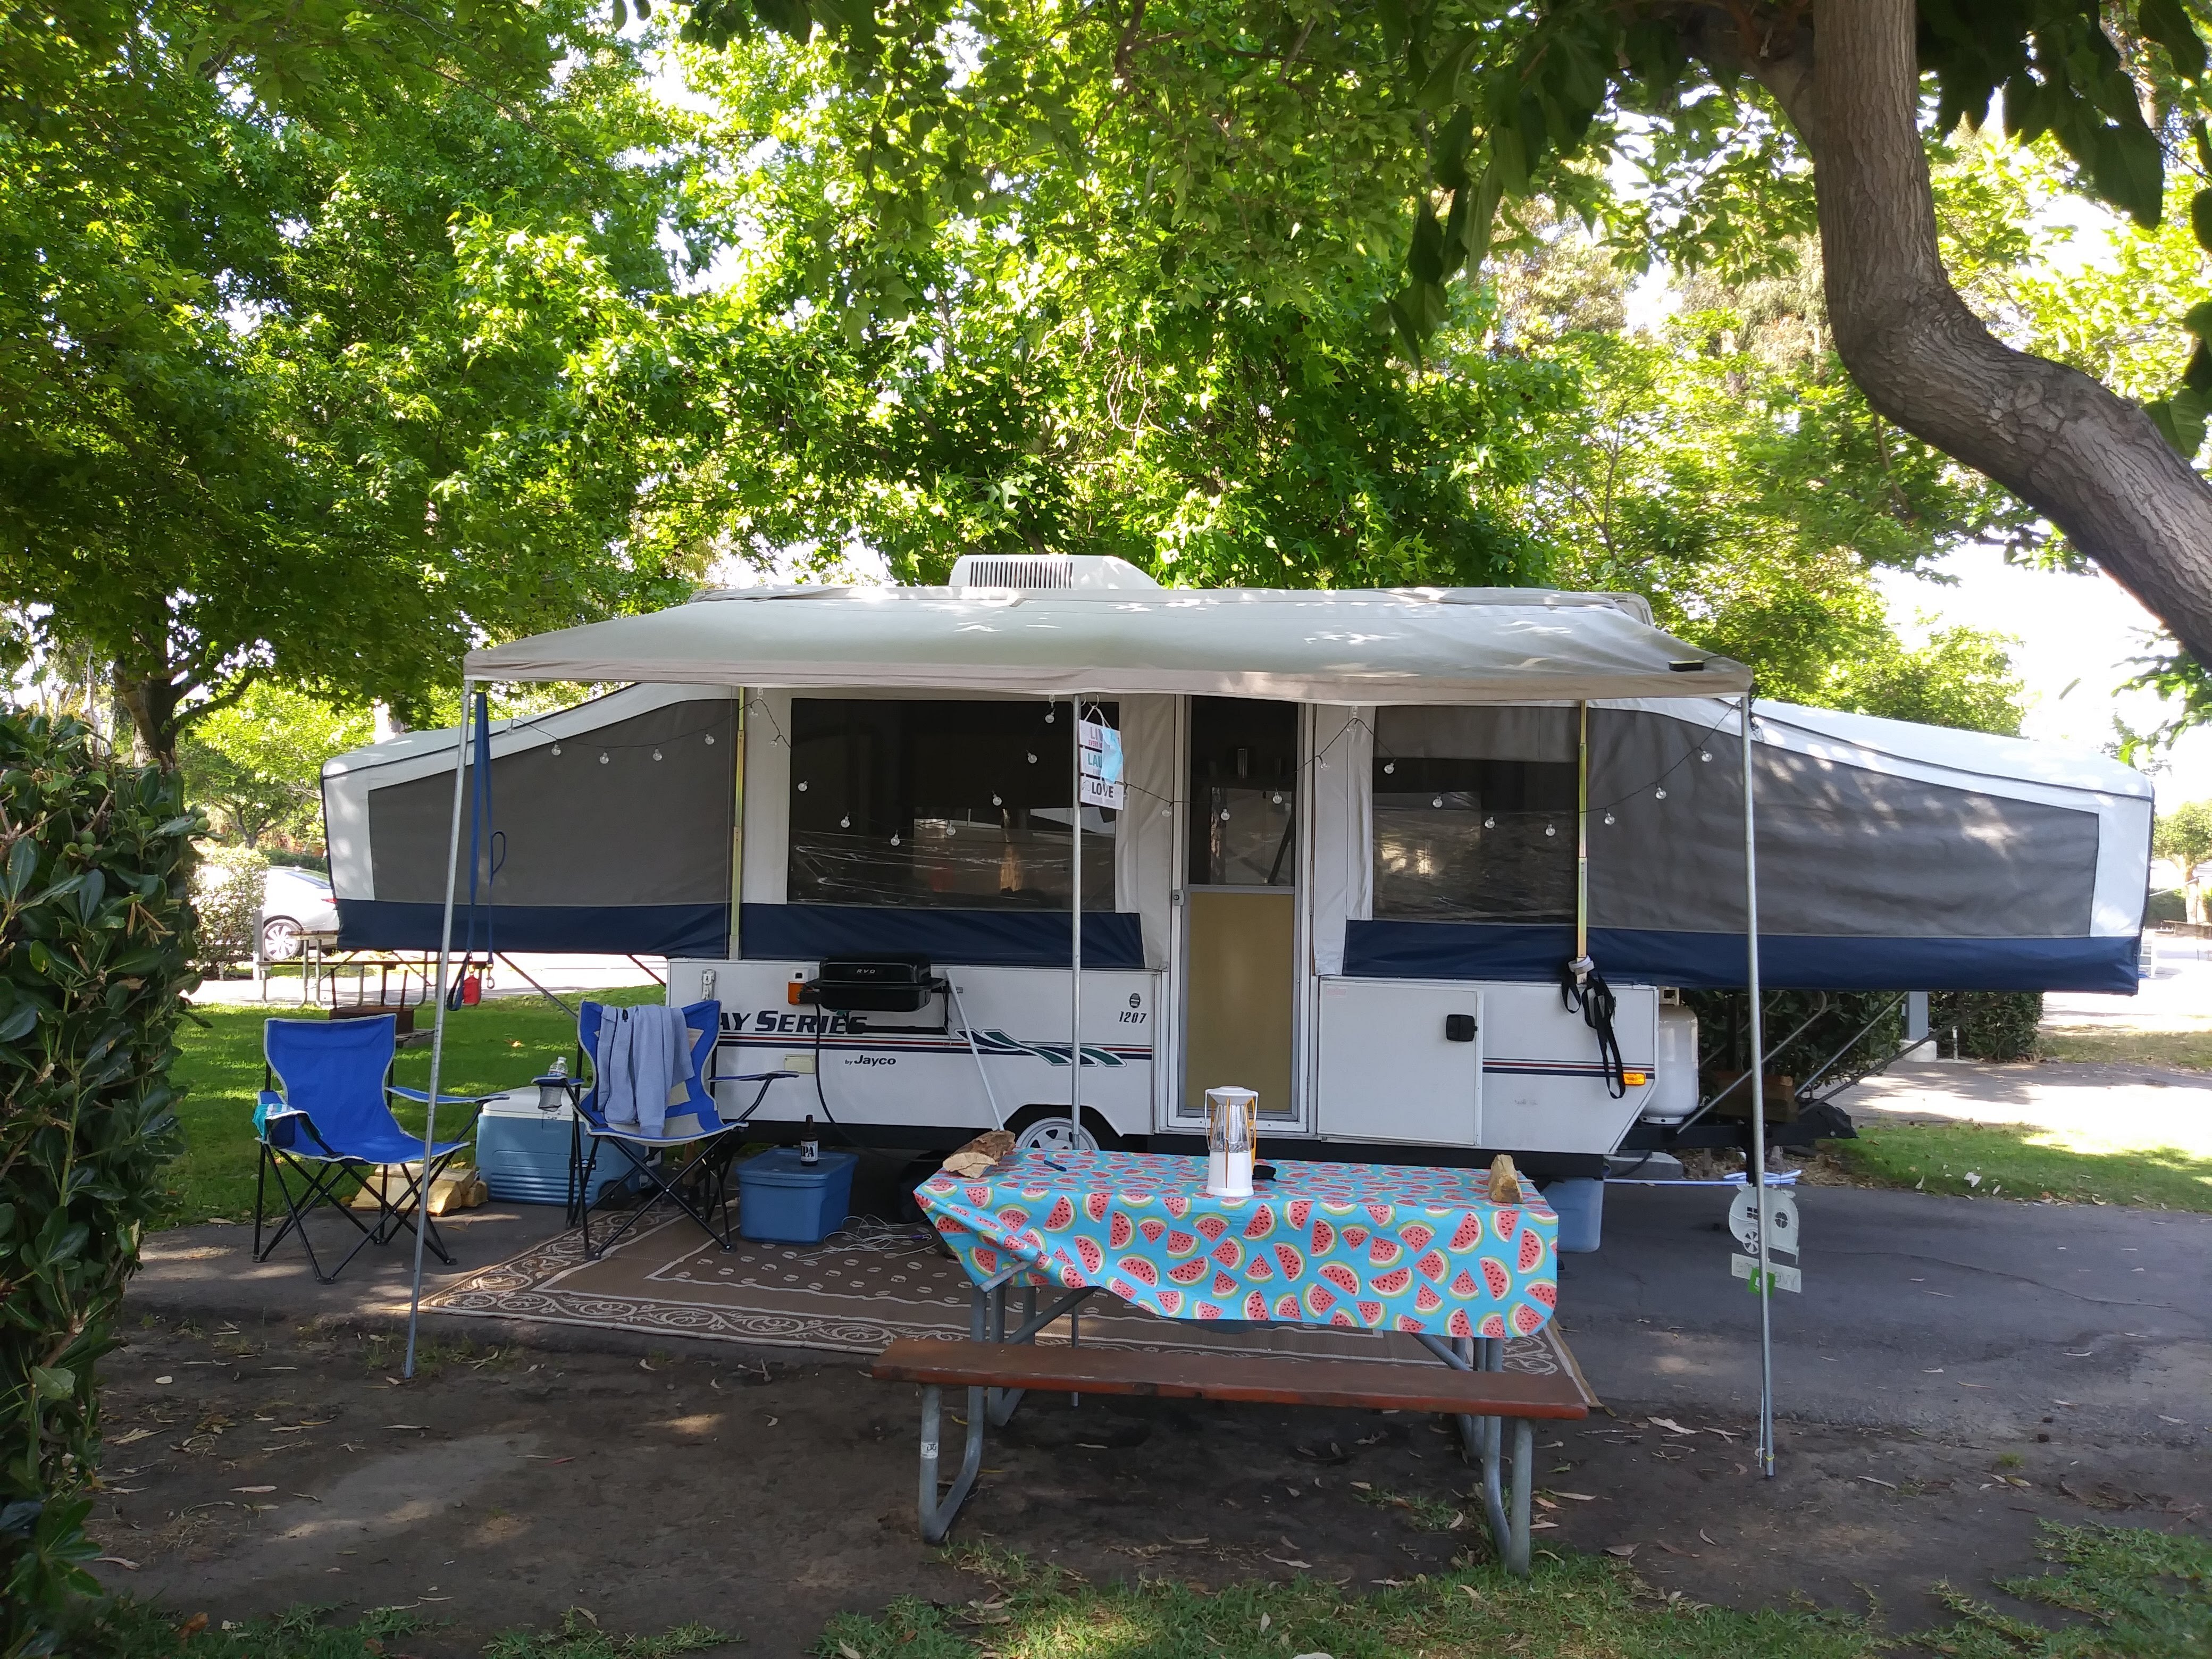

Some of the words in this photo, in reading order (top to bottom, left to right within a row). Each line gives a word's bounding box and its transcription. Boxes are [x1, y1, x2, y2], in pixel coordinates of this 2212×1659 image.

[1090, 726, 1103, 742] LIV
[1088, 753, 1102, 768] LAU
[1092, 782, 1113, 798] LOVE
[720, 1012, 752, 1030] AY
[1119, 1011, 1147, 1024] 1207
[854, 1054, 896, 1067] Jayco
